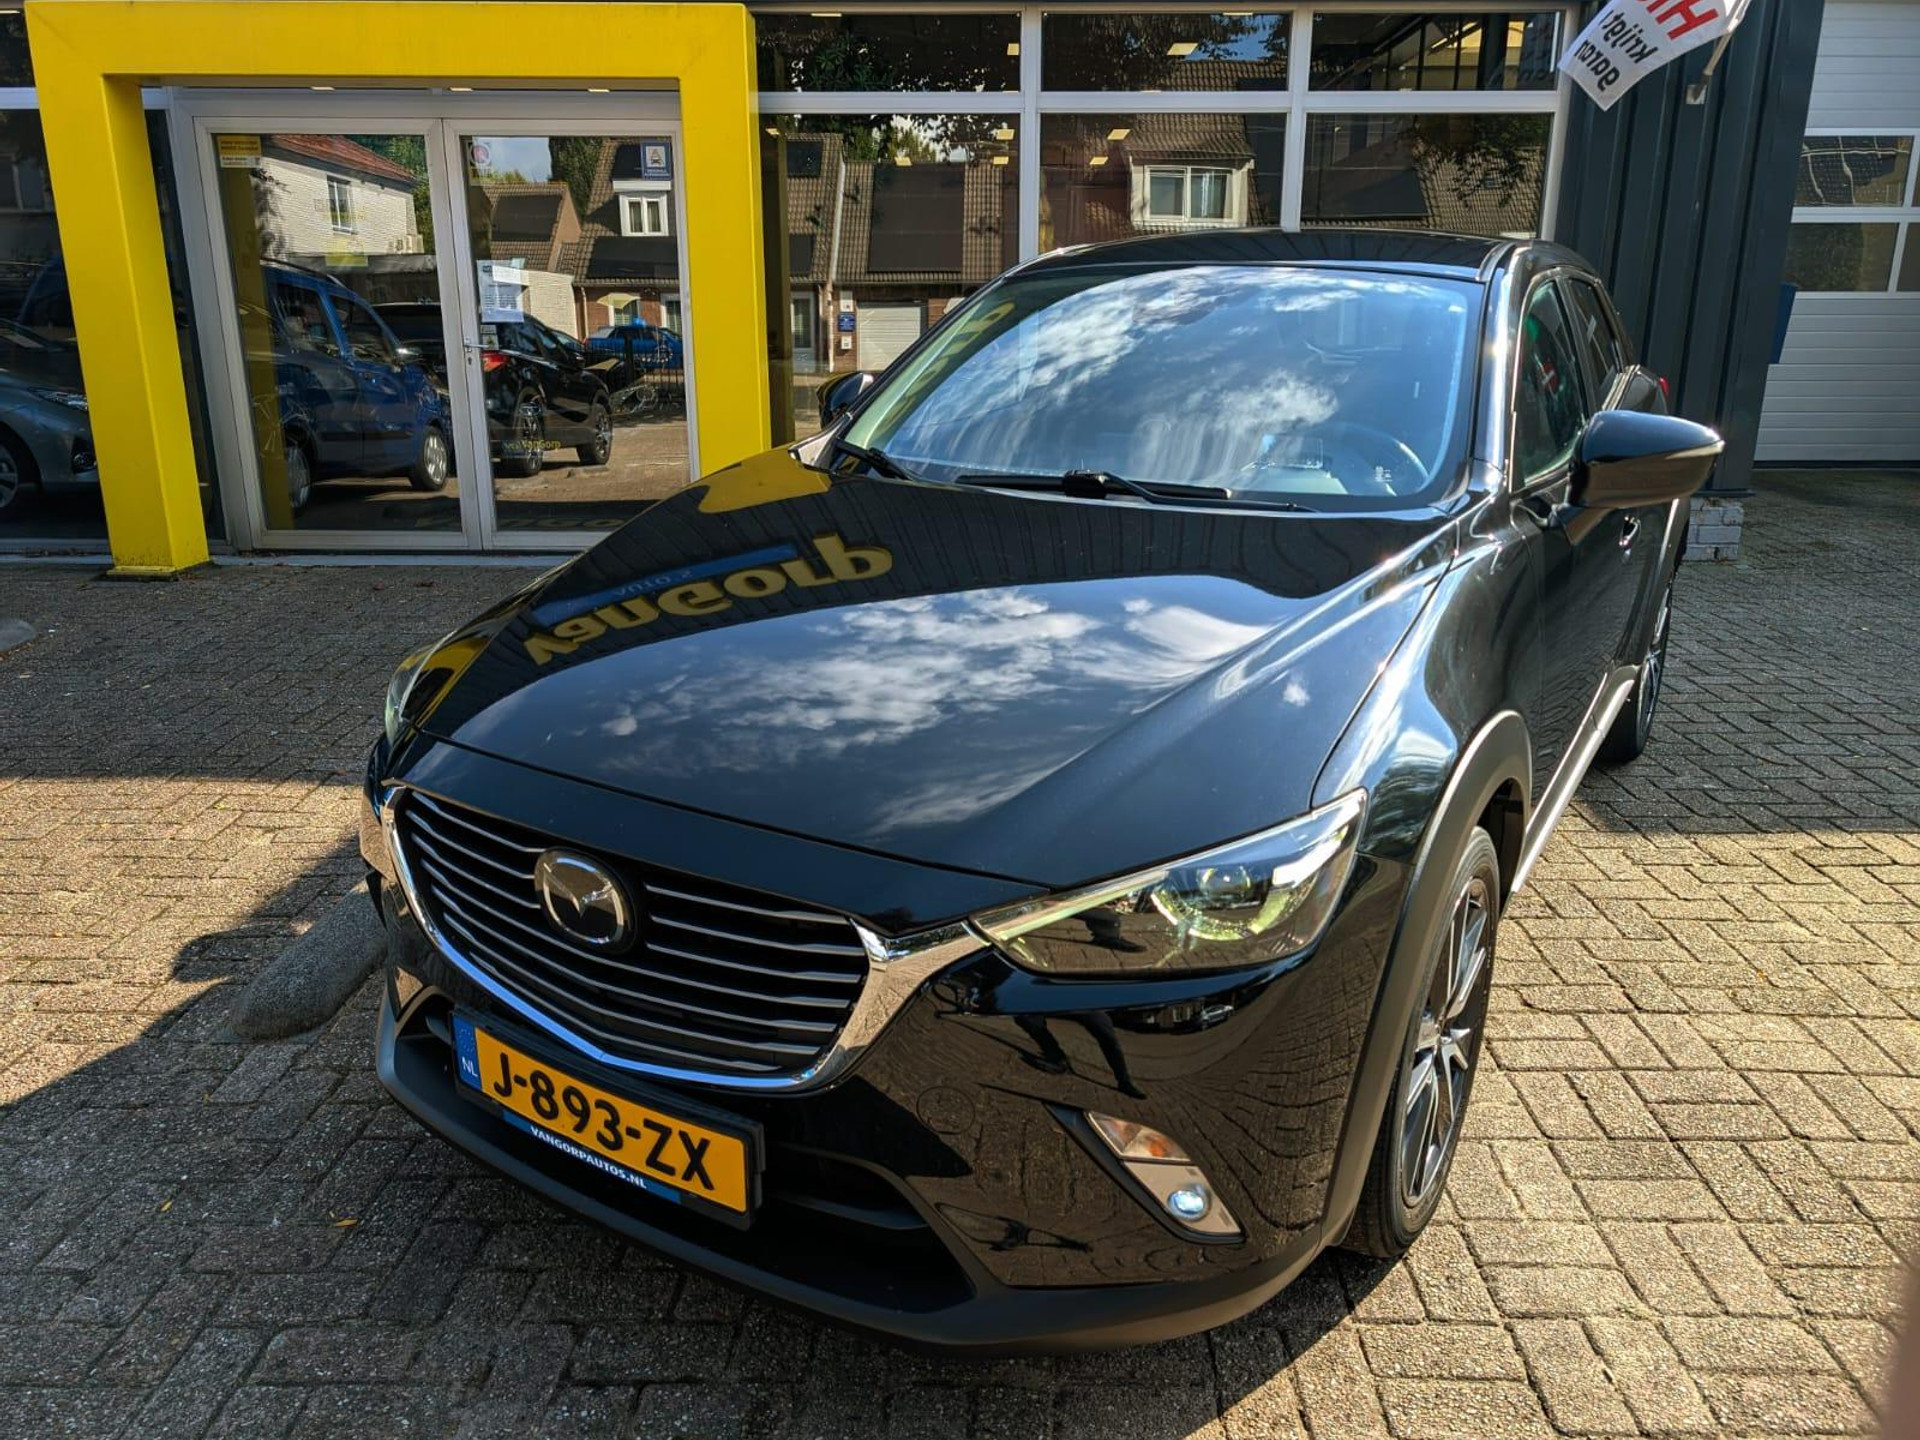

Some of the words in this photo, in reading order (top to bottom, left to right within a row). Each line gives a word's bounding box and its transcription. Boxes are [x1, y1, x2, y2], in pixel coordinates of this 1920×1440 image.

[461, 1056, 480, 1079] NL
[493, 1052, 715, 1191] J-893-ZX
[529, 1125, 648, 1190] VANGORPAUTOS.NL
